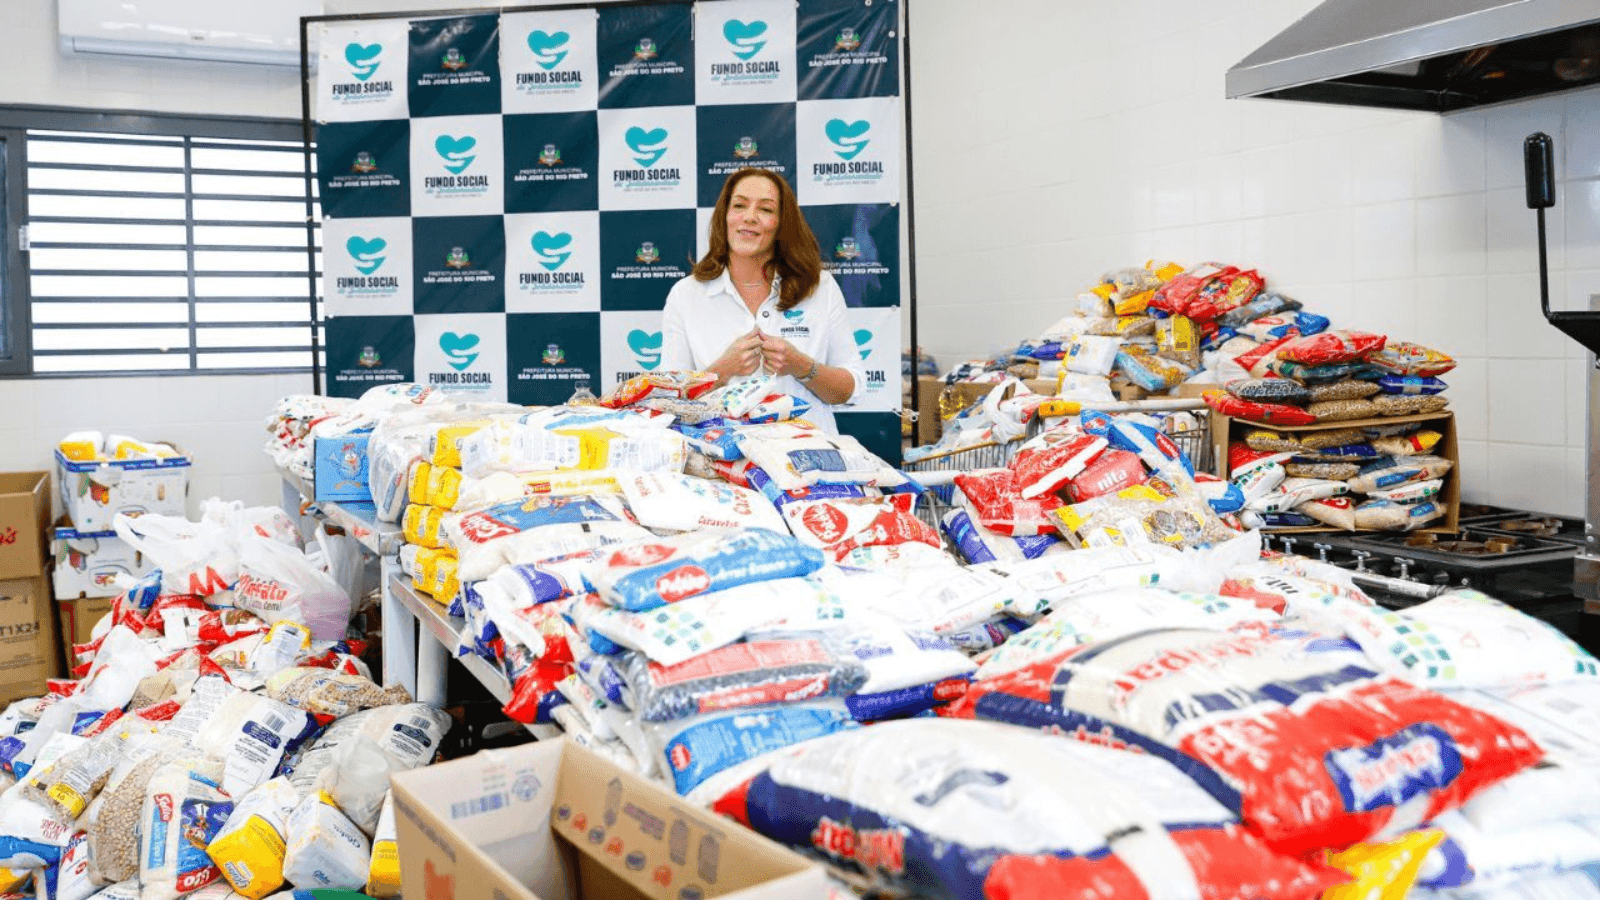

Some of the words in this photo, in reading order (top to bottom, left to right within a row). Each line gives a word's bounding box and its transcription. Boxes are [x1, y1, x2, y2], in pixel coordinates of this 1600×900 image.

[711, 63, 743, 75] FUNDO
[746, 61, 780, 73] SOCIAL
[516, 72, 546, 84] FUNDO
[549, 71, 582, 83] SOCIAL
[333, 84, 361, 94] FUNDO
[364, 81, 392, 92] SOCIAL
[814, 163, 845, 175] FUNDO
[848, 162, 883, 173] SOCIAL
[614, 170, 645, 181] FUNDO
[647, 169, 680, 180] SOCIAL
[425, 177, 454, 187] FUNDO
[457, 176, 489, 186] SOCIAL
[337, 277, 366, 288] FUNDO
[368, 277, 398, 287] SOCIAL
[520, 273, 550, 284] FUNDO
[553, 273, 585, 283] SOCIAL
[430, 373, 458, 383] FUNDO
[461, 373, 492, 383] SOCIAL
